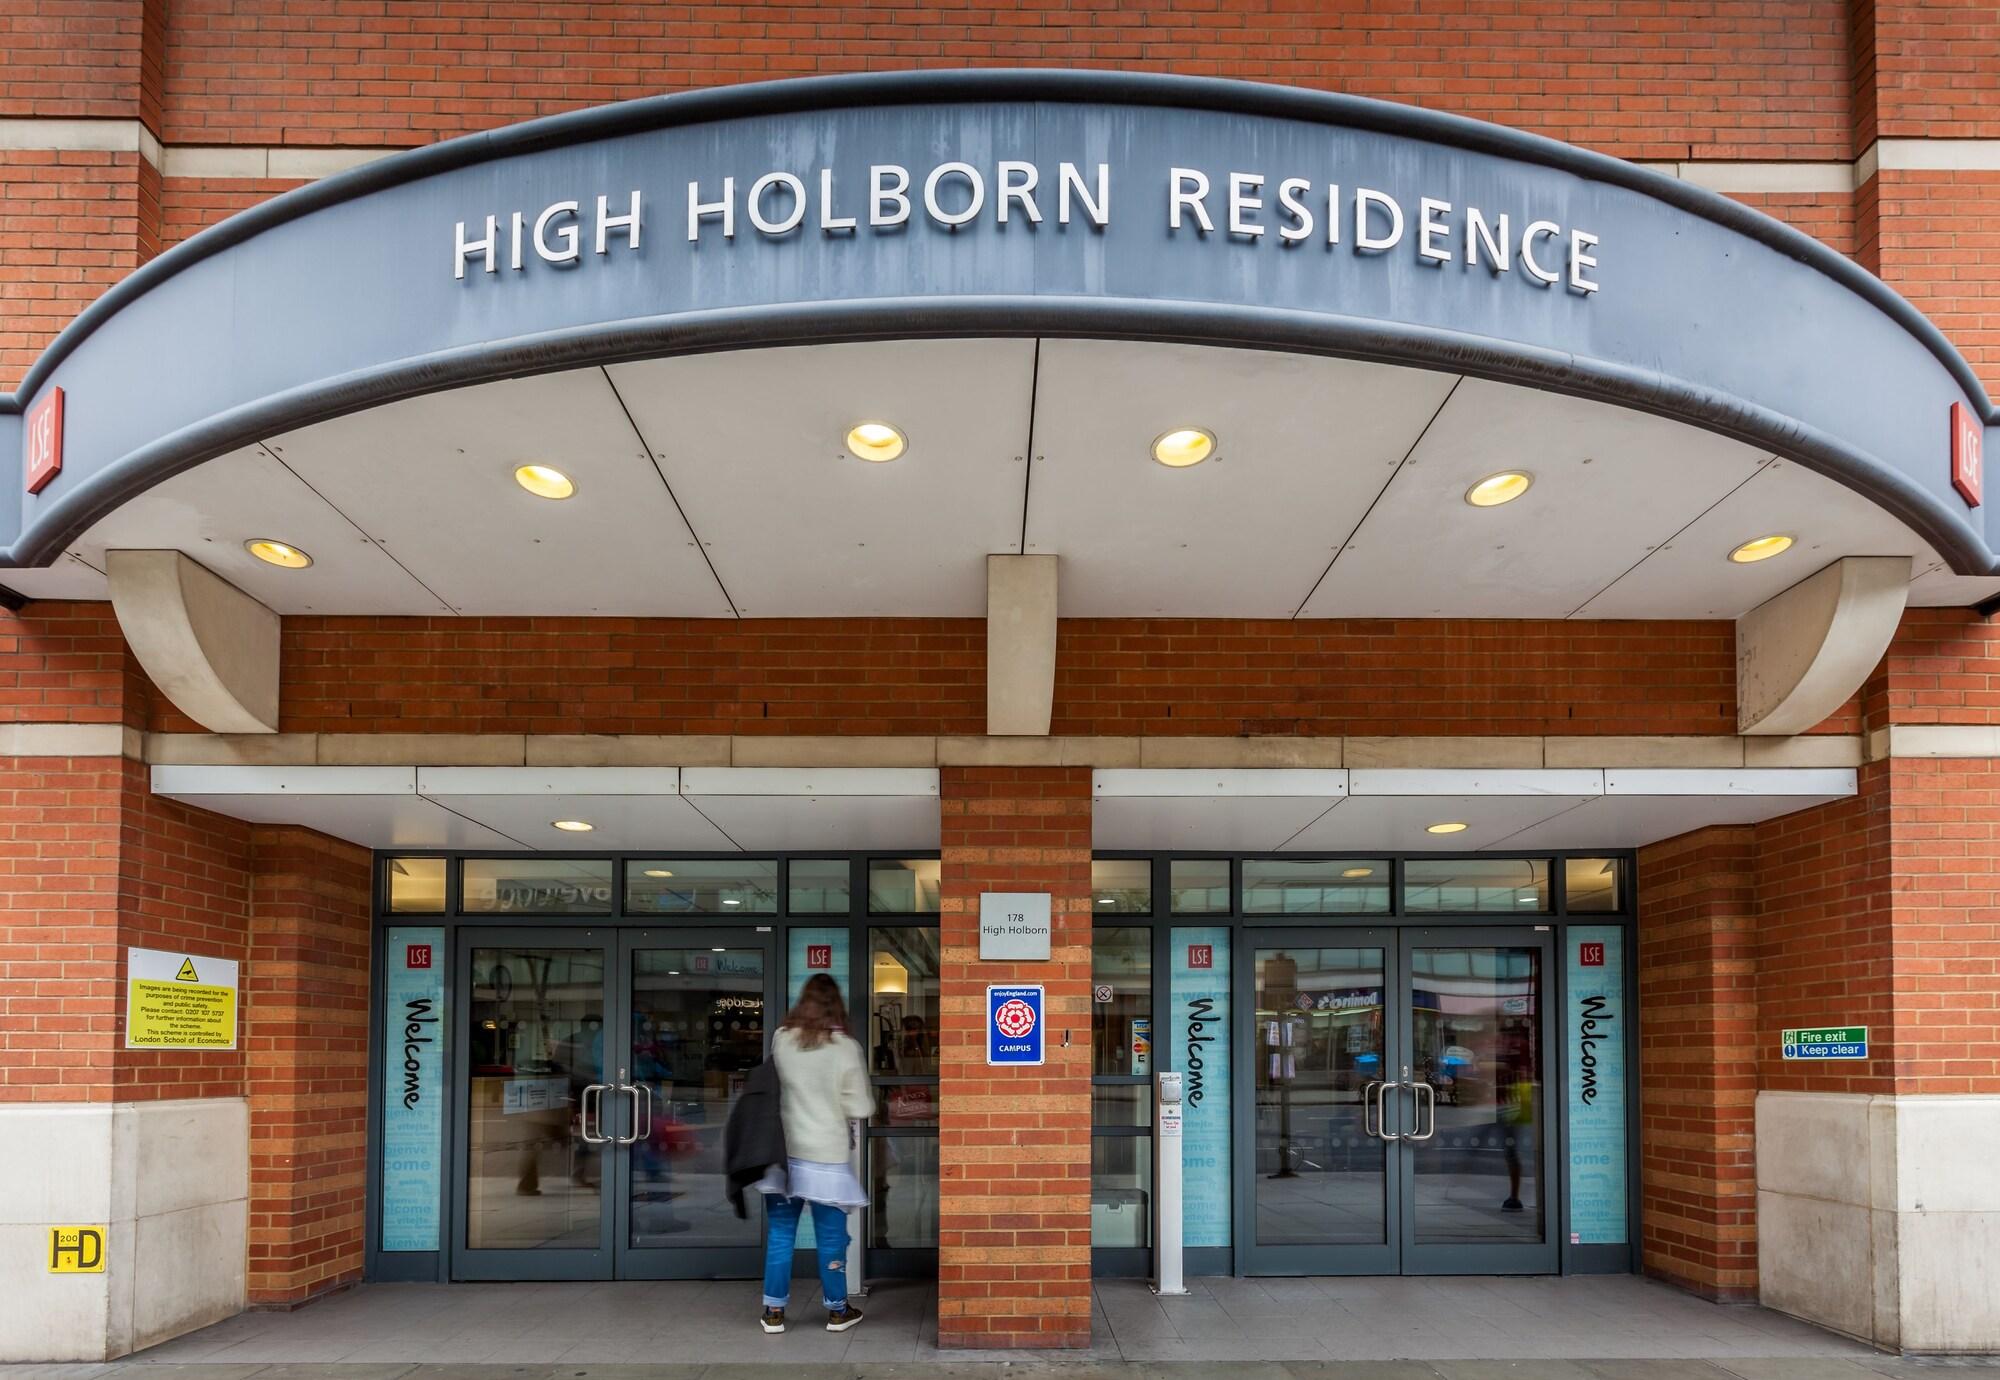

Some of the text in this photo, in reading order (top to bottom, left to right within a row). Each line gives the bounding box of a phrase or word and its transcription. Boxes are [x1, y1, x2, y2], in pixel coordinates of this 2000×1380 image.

[454, 160, 1599, 293] HIGH HOLBORN RESIDENCE
[31, 406, 51, 473] LSE
[1963, 421, 1979, 486] LSE
[1007, 914, 1024, 922] 178
[983, 925, 1048, 936] High Holborn
[411, 949, 428, 965] LSE
[811, 949, 828, 965] LSE
[1192, 949, 1208, 965] LSE
[1584, 947, 1600, 963] LSE
[139, 983, 160, 992] Images
[188, 988, 211, 996] recorded
[994, 990, 1037, 998] enjoyEngland.com
[1801, 1031, 1847, 1042] Fire exit
[403, 999, 439, 1110] Welcome
[1188, 998, 1221, 1108] Welcome
[1580, 996, 1614, 1106] Welcome
[1801, 1044, 1859, 1056] Keep clear
